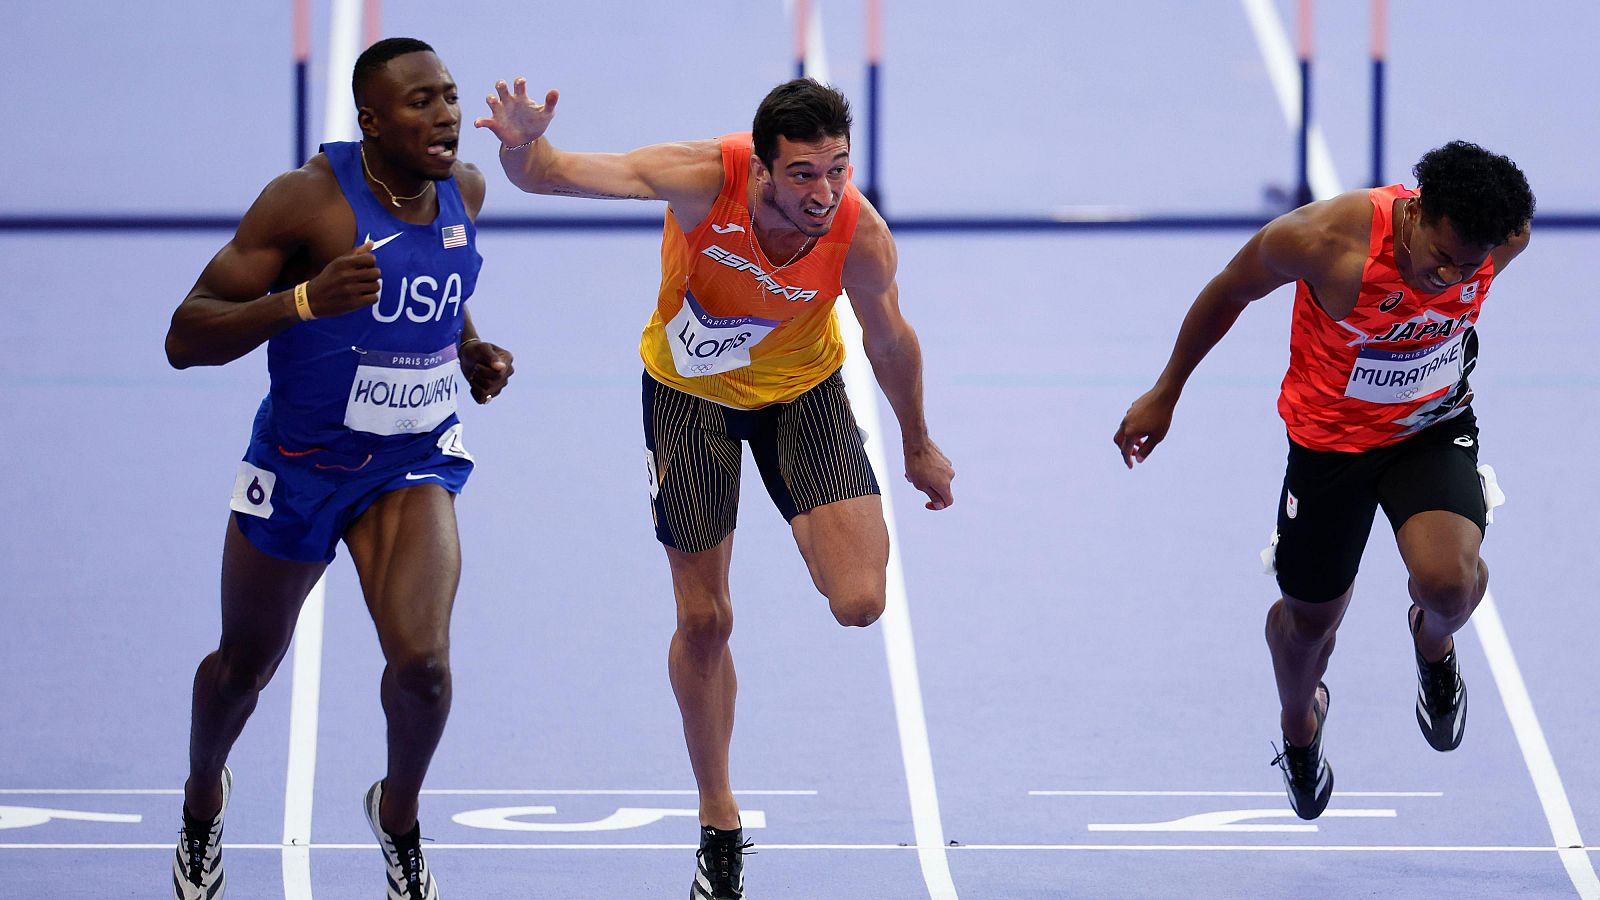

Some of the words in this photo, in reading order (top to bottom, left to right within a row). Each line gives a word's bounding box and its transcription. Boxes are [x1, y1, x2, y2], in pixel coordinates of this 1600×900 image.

[371, 272, 462, 323] USA
[701, 314, 728, 325] PARIS
[678, 320, 752, 359] LLOPIS
[1391, 351, 1420, 359] PARIS
[392, 356, 421, 366] PARIS
[1352, 341, 1460, 387] MURATAKE
[354, 374, 454, 409] HOLLOWAY
[247, 476, 265, 505] 6
